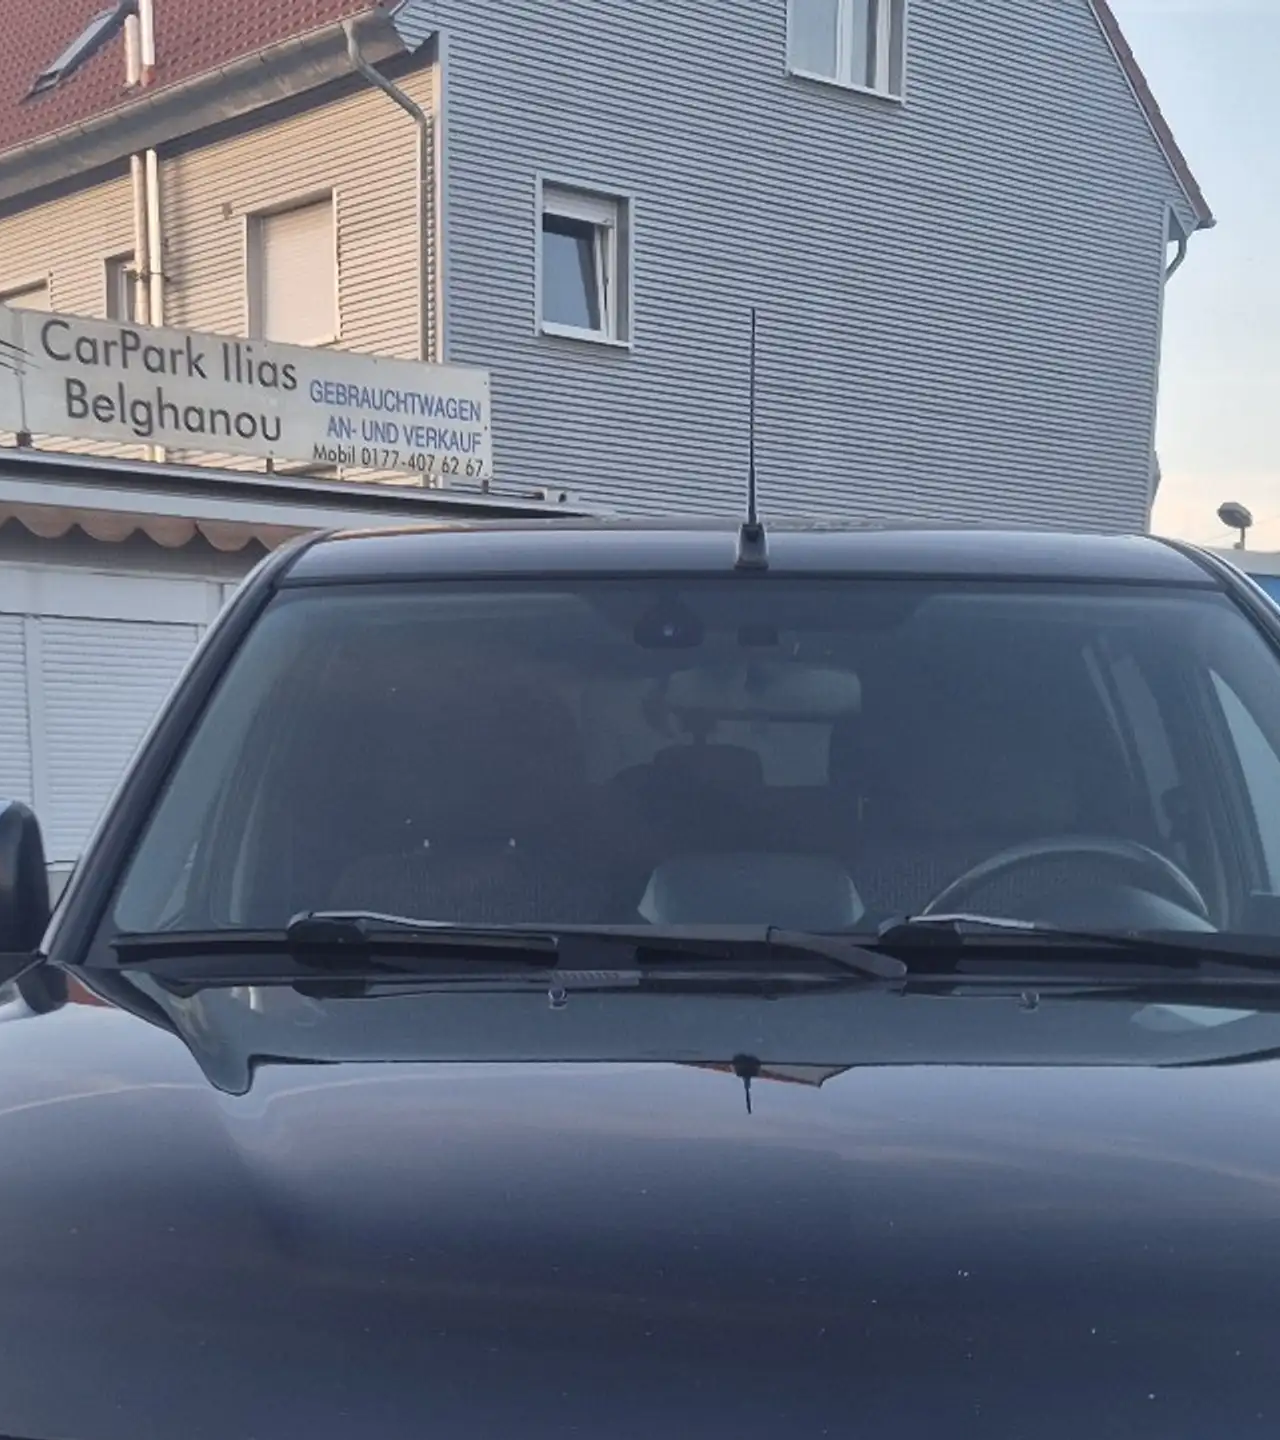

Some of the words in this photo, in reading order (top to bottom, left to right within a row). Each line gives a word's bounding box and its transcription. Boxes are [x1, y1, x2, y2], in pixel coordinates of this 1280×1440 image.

[40, 318, 208, 379] CarPark
[222, 341, 298, 391] Ilias
[65, 376, 282, 442] Belghanou
[309, 379, 482, 422] GEBRAUCHTWAGEN
[326, 414, 357, 441] AN-
[361, 418, 400, 445] UND
[403, 424, 483, 454] VERKAUF
[312, 442, 356, 466] Mobil
[361, 447, 436, 473] 0177-407
[442, 455, 460, 476] 62
